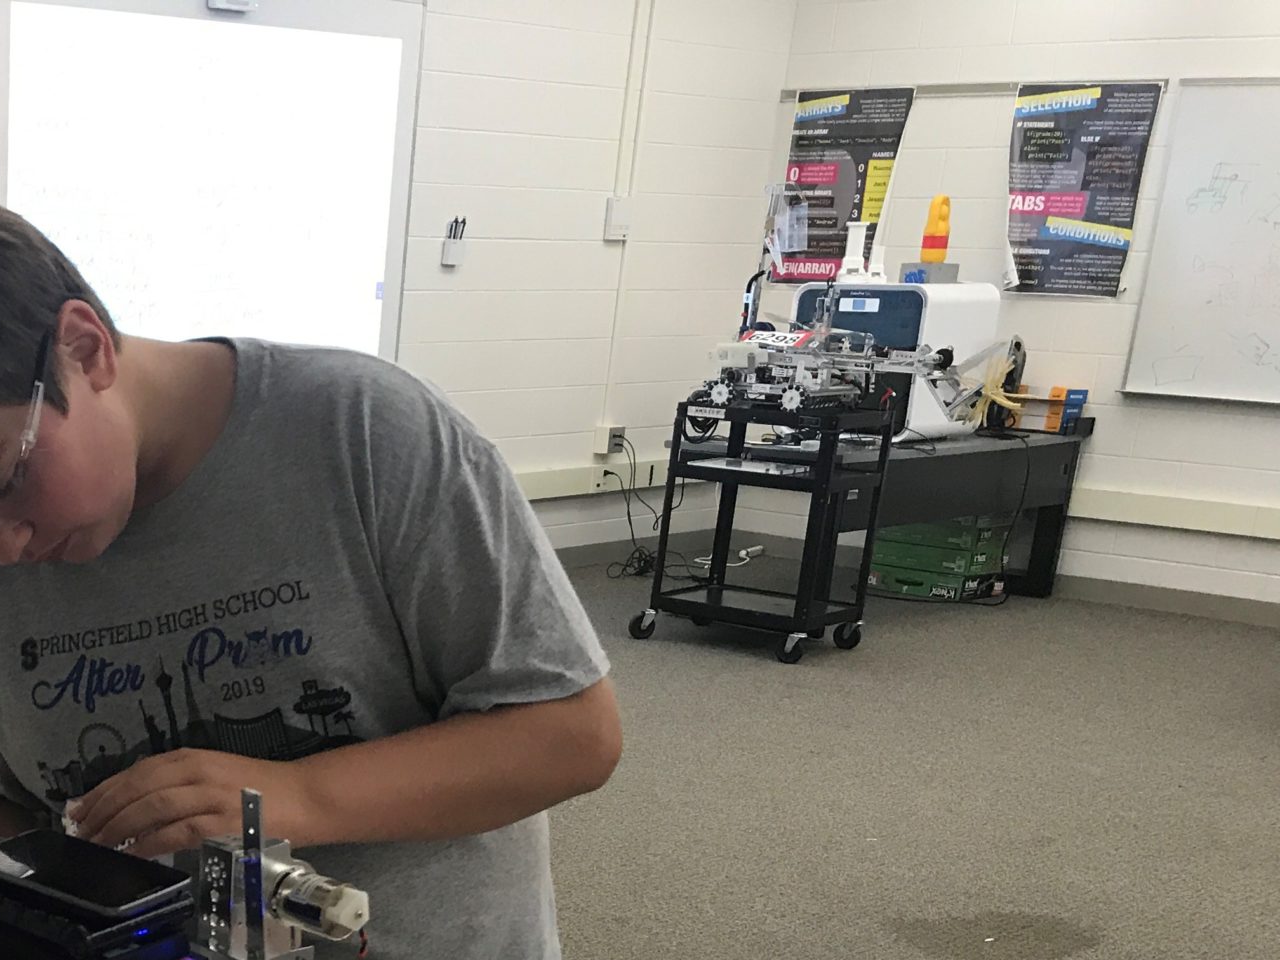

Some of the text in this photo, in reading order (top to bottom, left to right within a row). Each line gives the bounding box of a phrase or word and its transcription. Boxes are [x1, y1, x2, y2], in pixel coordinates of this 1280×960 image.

[797, 102, 842, 118] ARRAYS
[1021, 94, 1092, 113] SELECTION
[790, 167, 799, 182] 0
[858, 163, 865, 173] 0
[857, 179, 862, 188] 1
[853, 194, 860, 203] 2
[1008, 195, 1045, 211] TABS
[851, 209, 858, 218] 3
[1049, 223, 1125, 246] CONDITIONS
[20, 579, 311, 671] SPRINGFIELD HIGH SCHOOL
[31, 653, 146, 714] After
[221, 675, 266, 702] 2019
